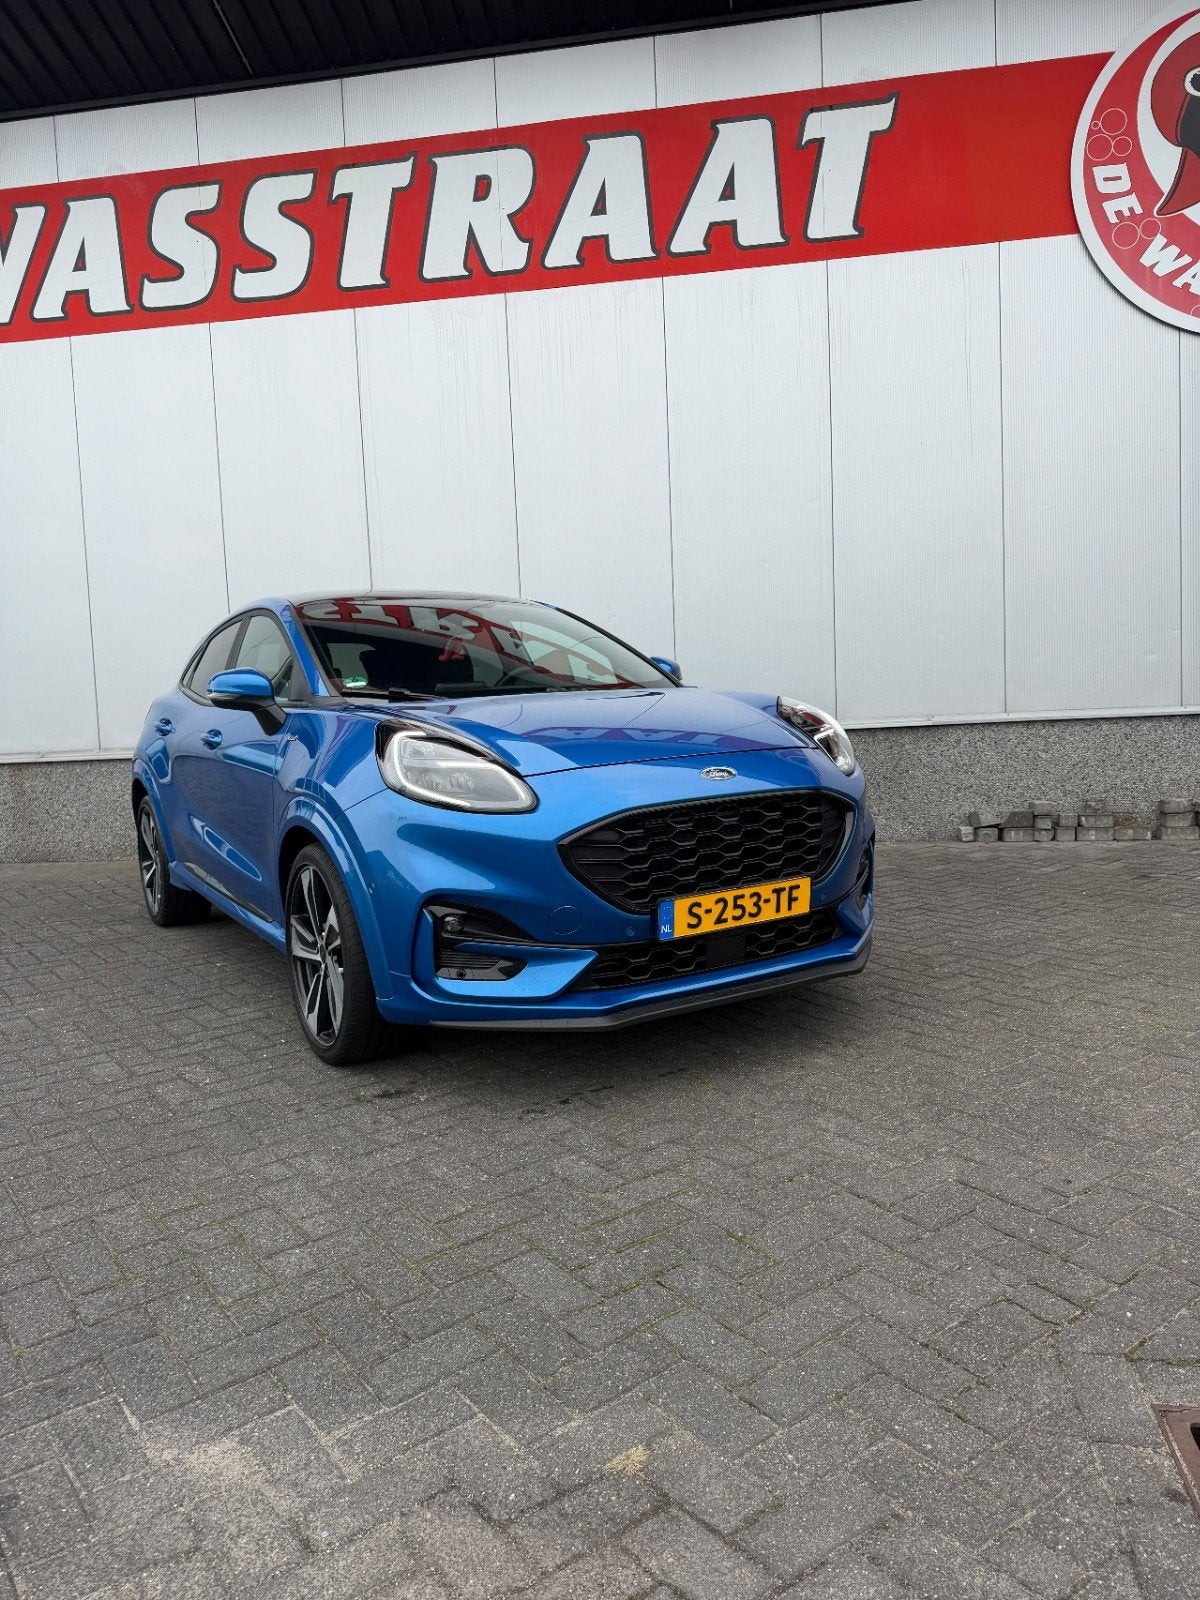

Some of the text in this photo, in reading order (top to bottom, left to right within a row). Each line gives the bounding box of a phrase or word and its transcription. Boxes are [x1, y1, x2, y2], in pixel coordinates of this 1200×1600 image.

[1092, 162, 1143, 224] DE
[660, 924, 672, 934] NL
[686, 884, 801, 929] S-253-TF
